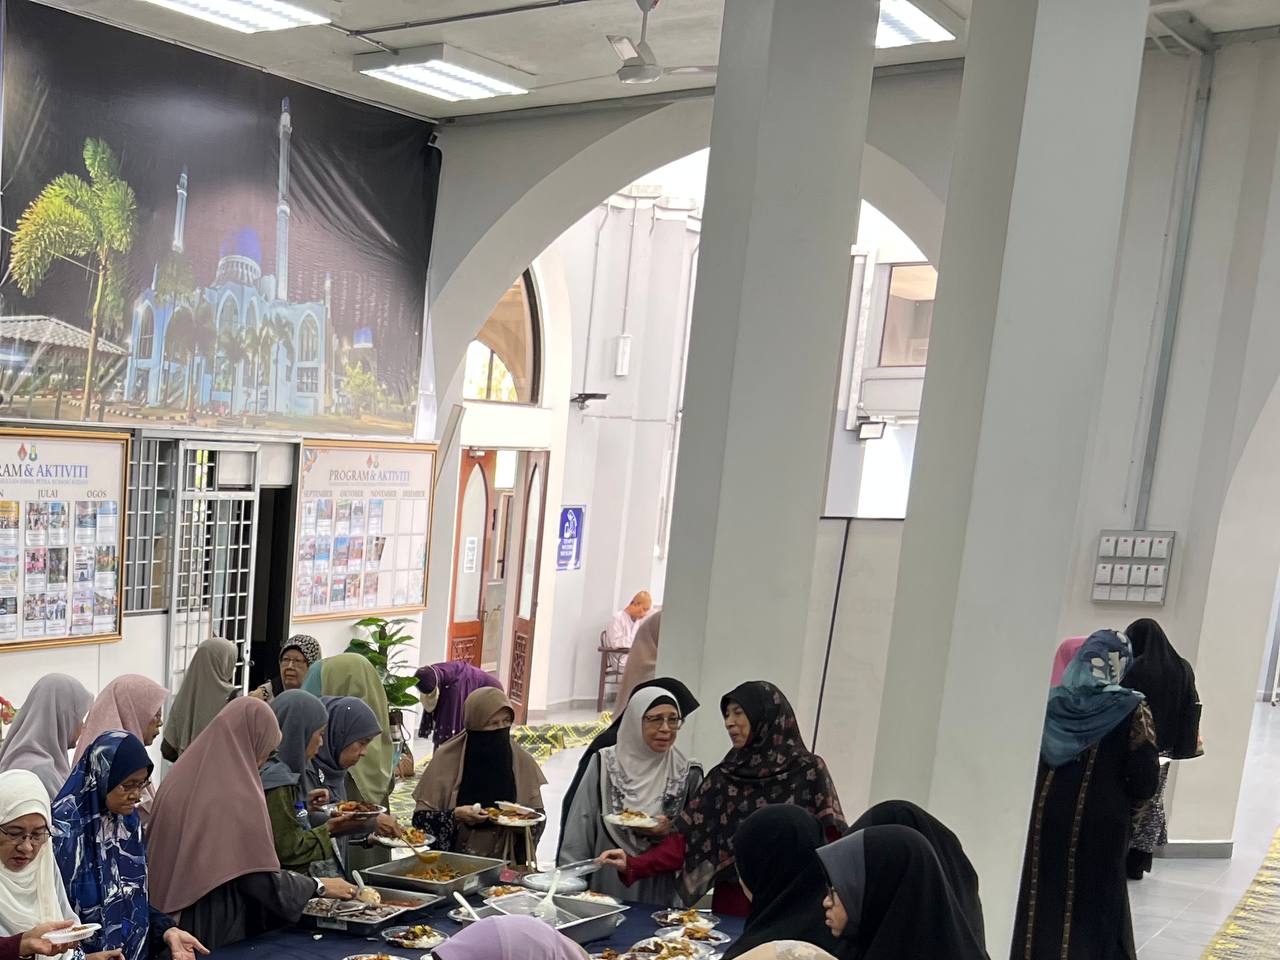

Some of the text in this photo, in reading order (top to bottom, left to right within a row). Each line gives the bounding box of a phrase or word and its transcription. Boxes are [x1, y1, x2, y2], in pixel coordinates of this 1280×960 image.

[24, 463, 33, 478] &
[36, 464, 89, 479] AKTIVITI
[329, 470, 368, 481] PROGRAM
[37, 489, 59, 499] JULAI
[86, 489, 108, 498] OGOS
